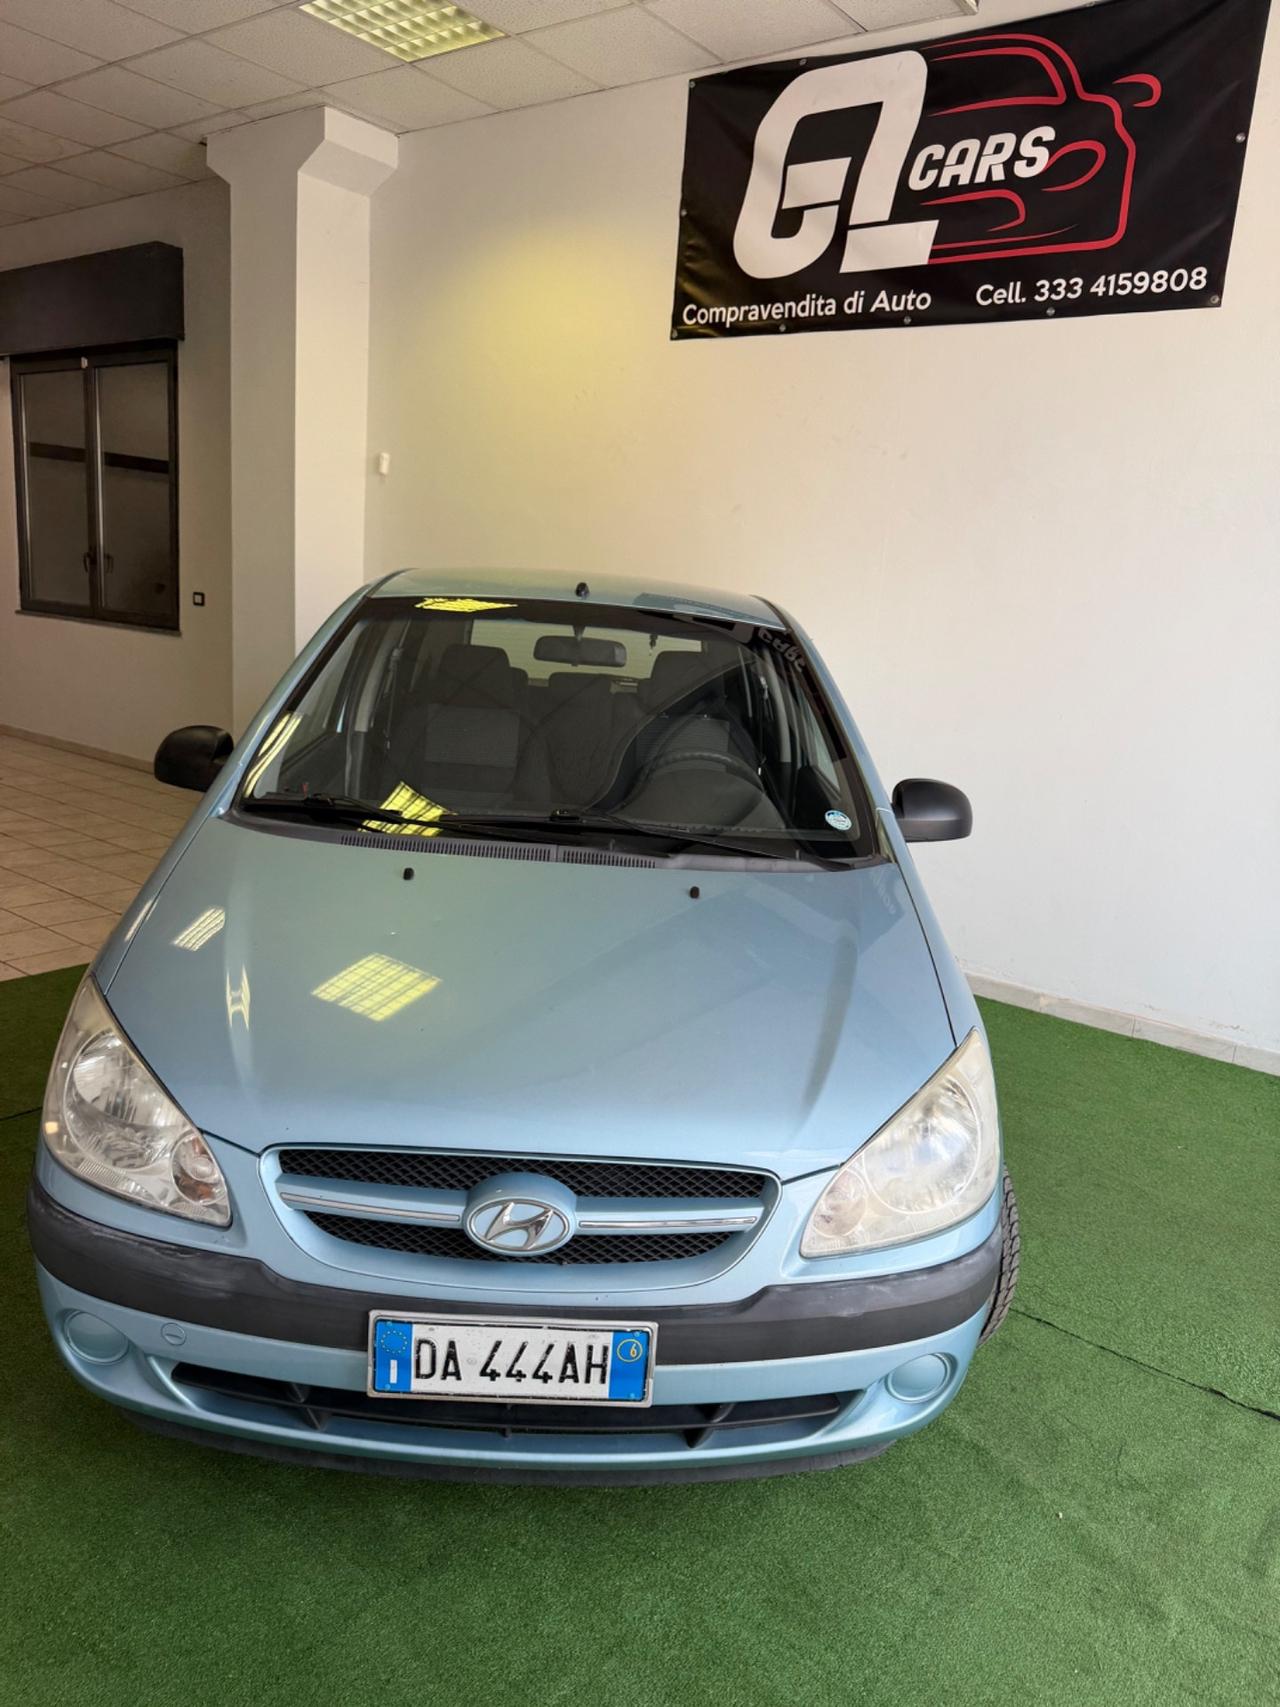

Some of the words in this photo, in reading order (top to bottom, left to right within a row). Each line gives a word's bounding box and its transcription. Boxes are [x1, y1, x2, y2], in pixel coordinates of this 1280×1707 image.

[908, 126, 1056, 191] CARS
[976, 281, 1026, 305] Cell.
[1034, 278, 1083, 300] 333
[1090, 266, 1207, 296] 4159808
[682, 294, 836, 328] Compravendita
[844, 291, 864, 313] di
[871, 290, 932, 312] Auto
[415, 1338, 462, 1381] DA
